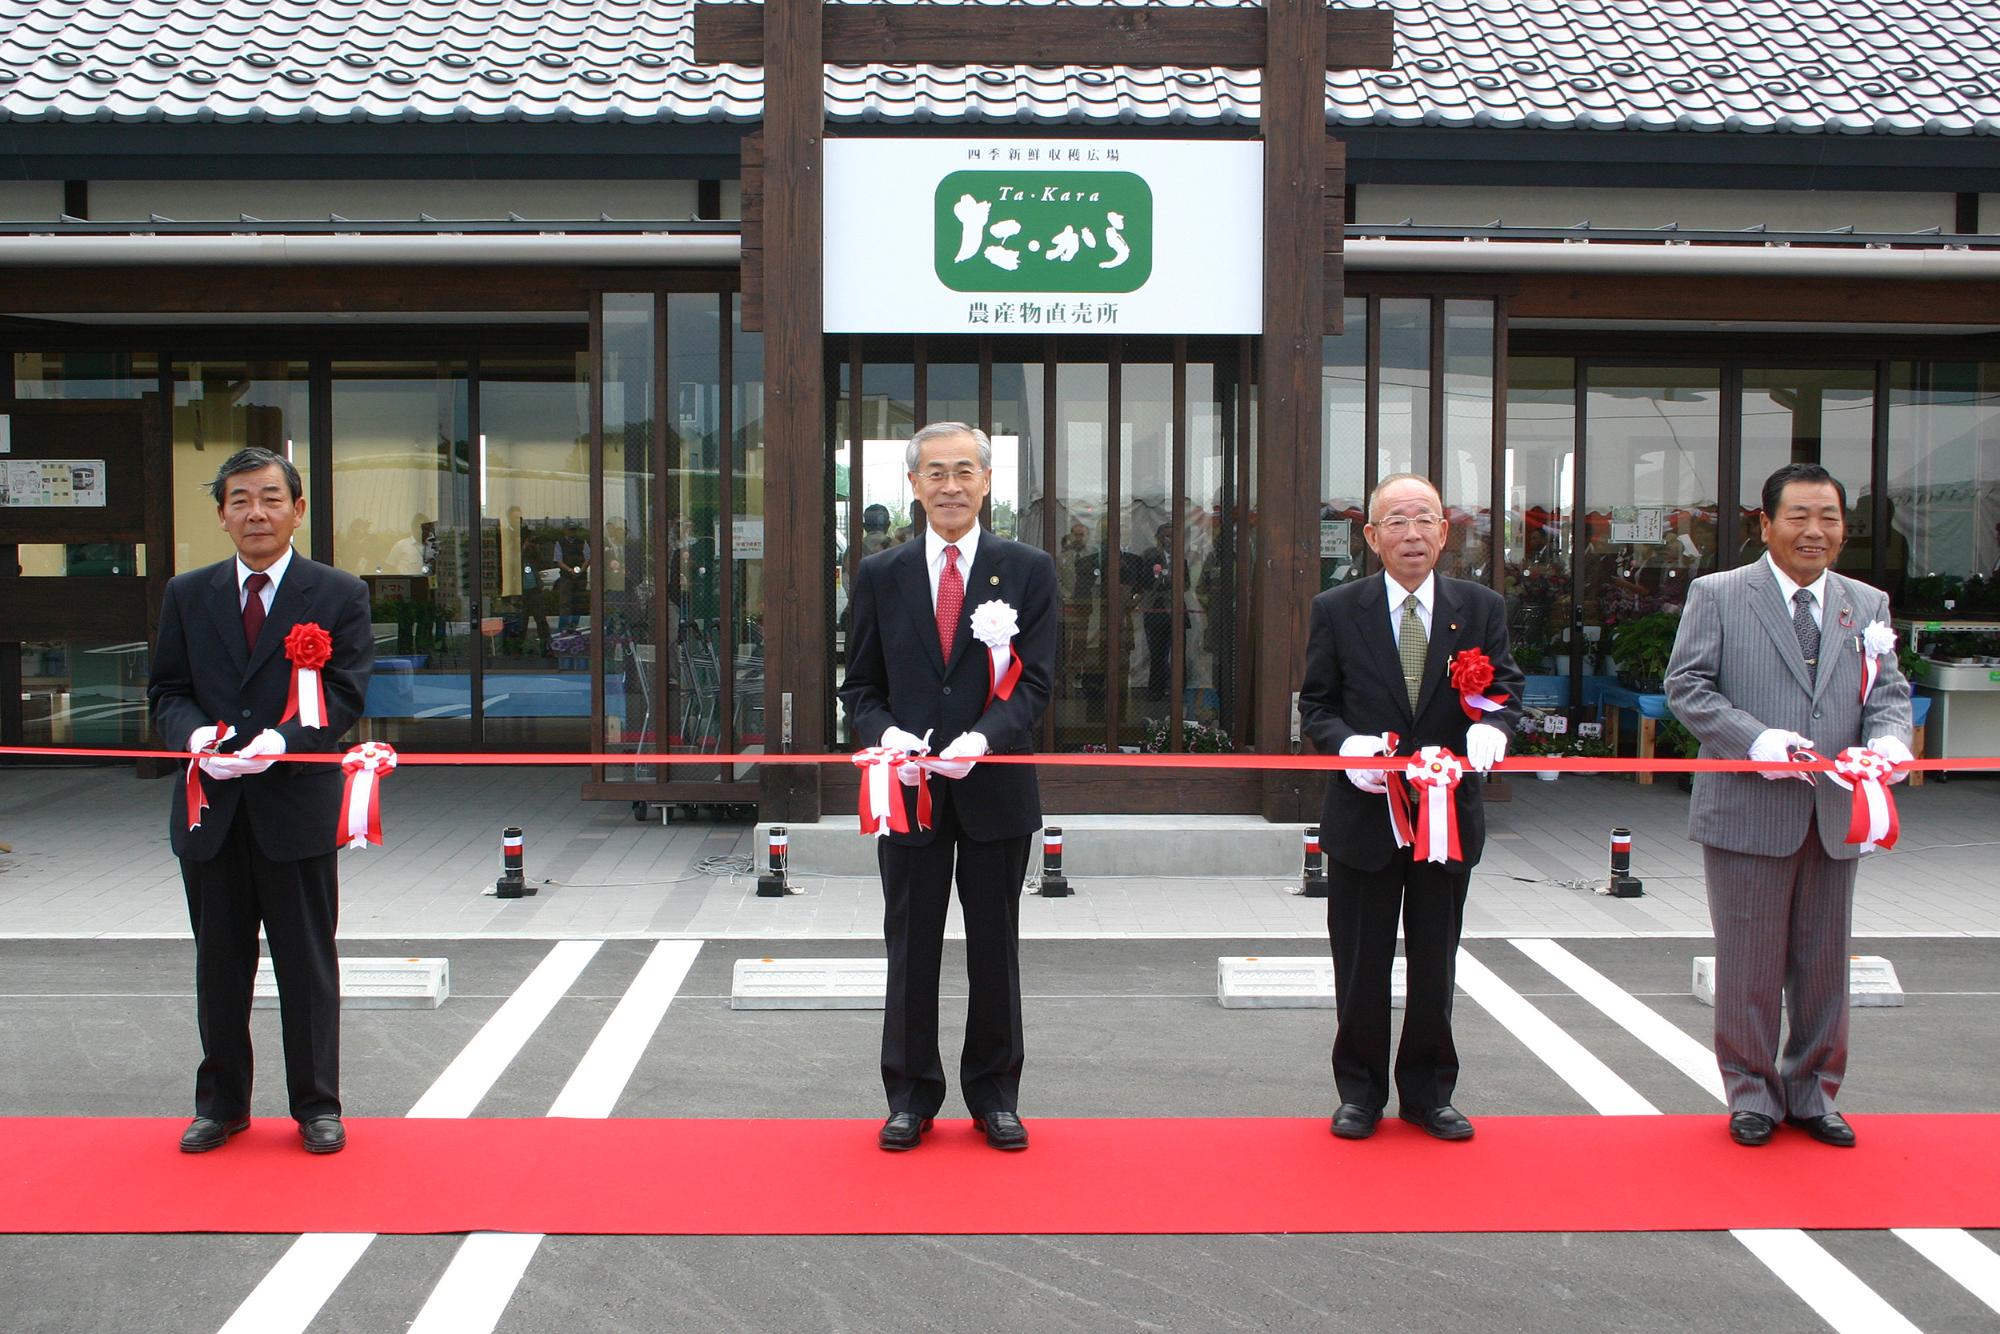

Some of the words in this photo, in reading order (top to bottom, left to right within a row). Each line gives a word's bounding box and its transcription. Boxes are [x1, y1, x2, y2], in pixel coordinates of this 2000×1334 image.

[967, 147, 1120, 162] 四季新鮮収穫広場
[967, 301, 1119, 325] 農産物直売所
